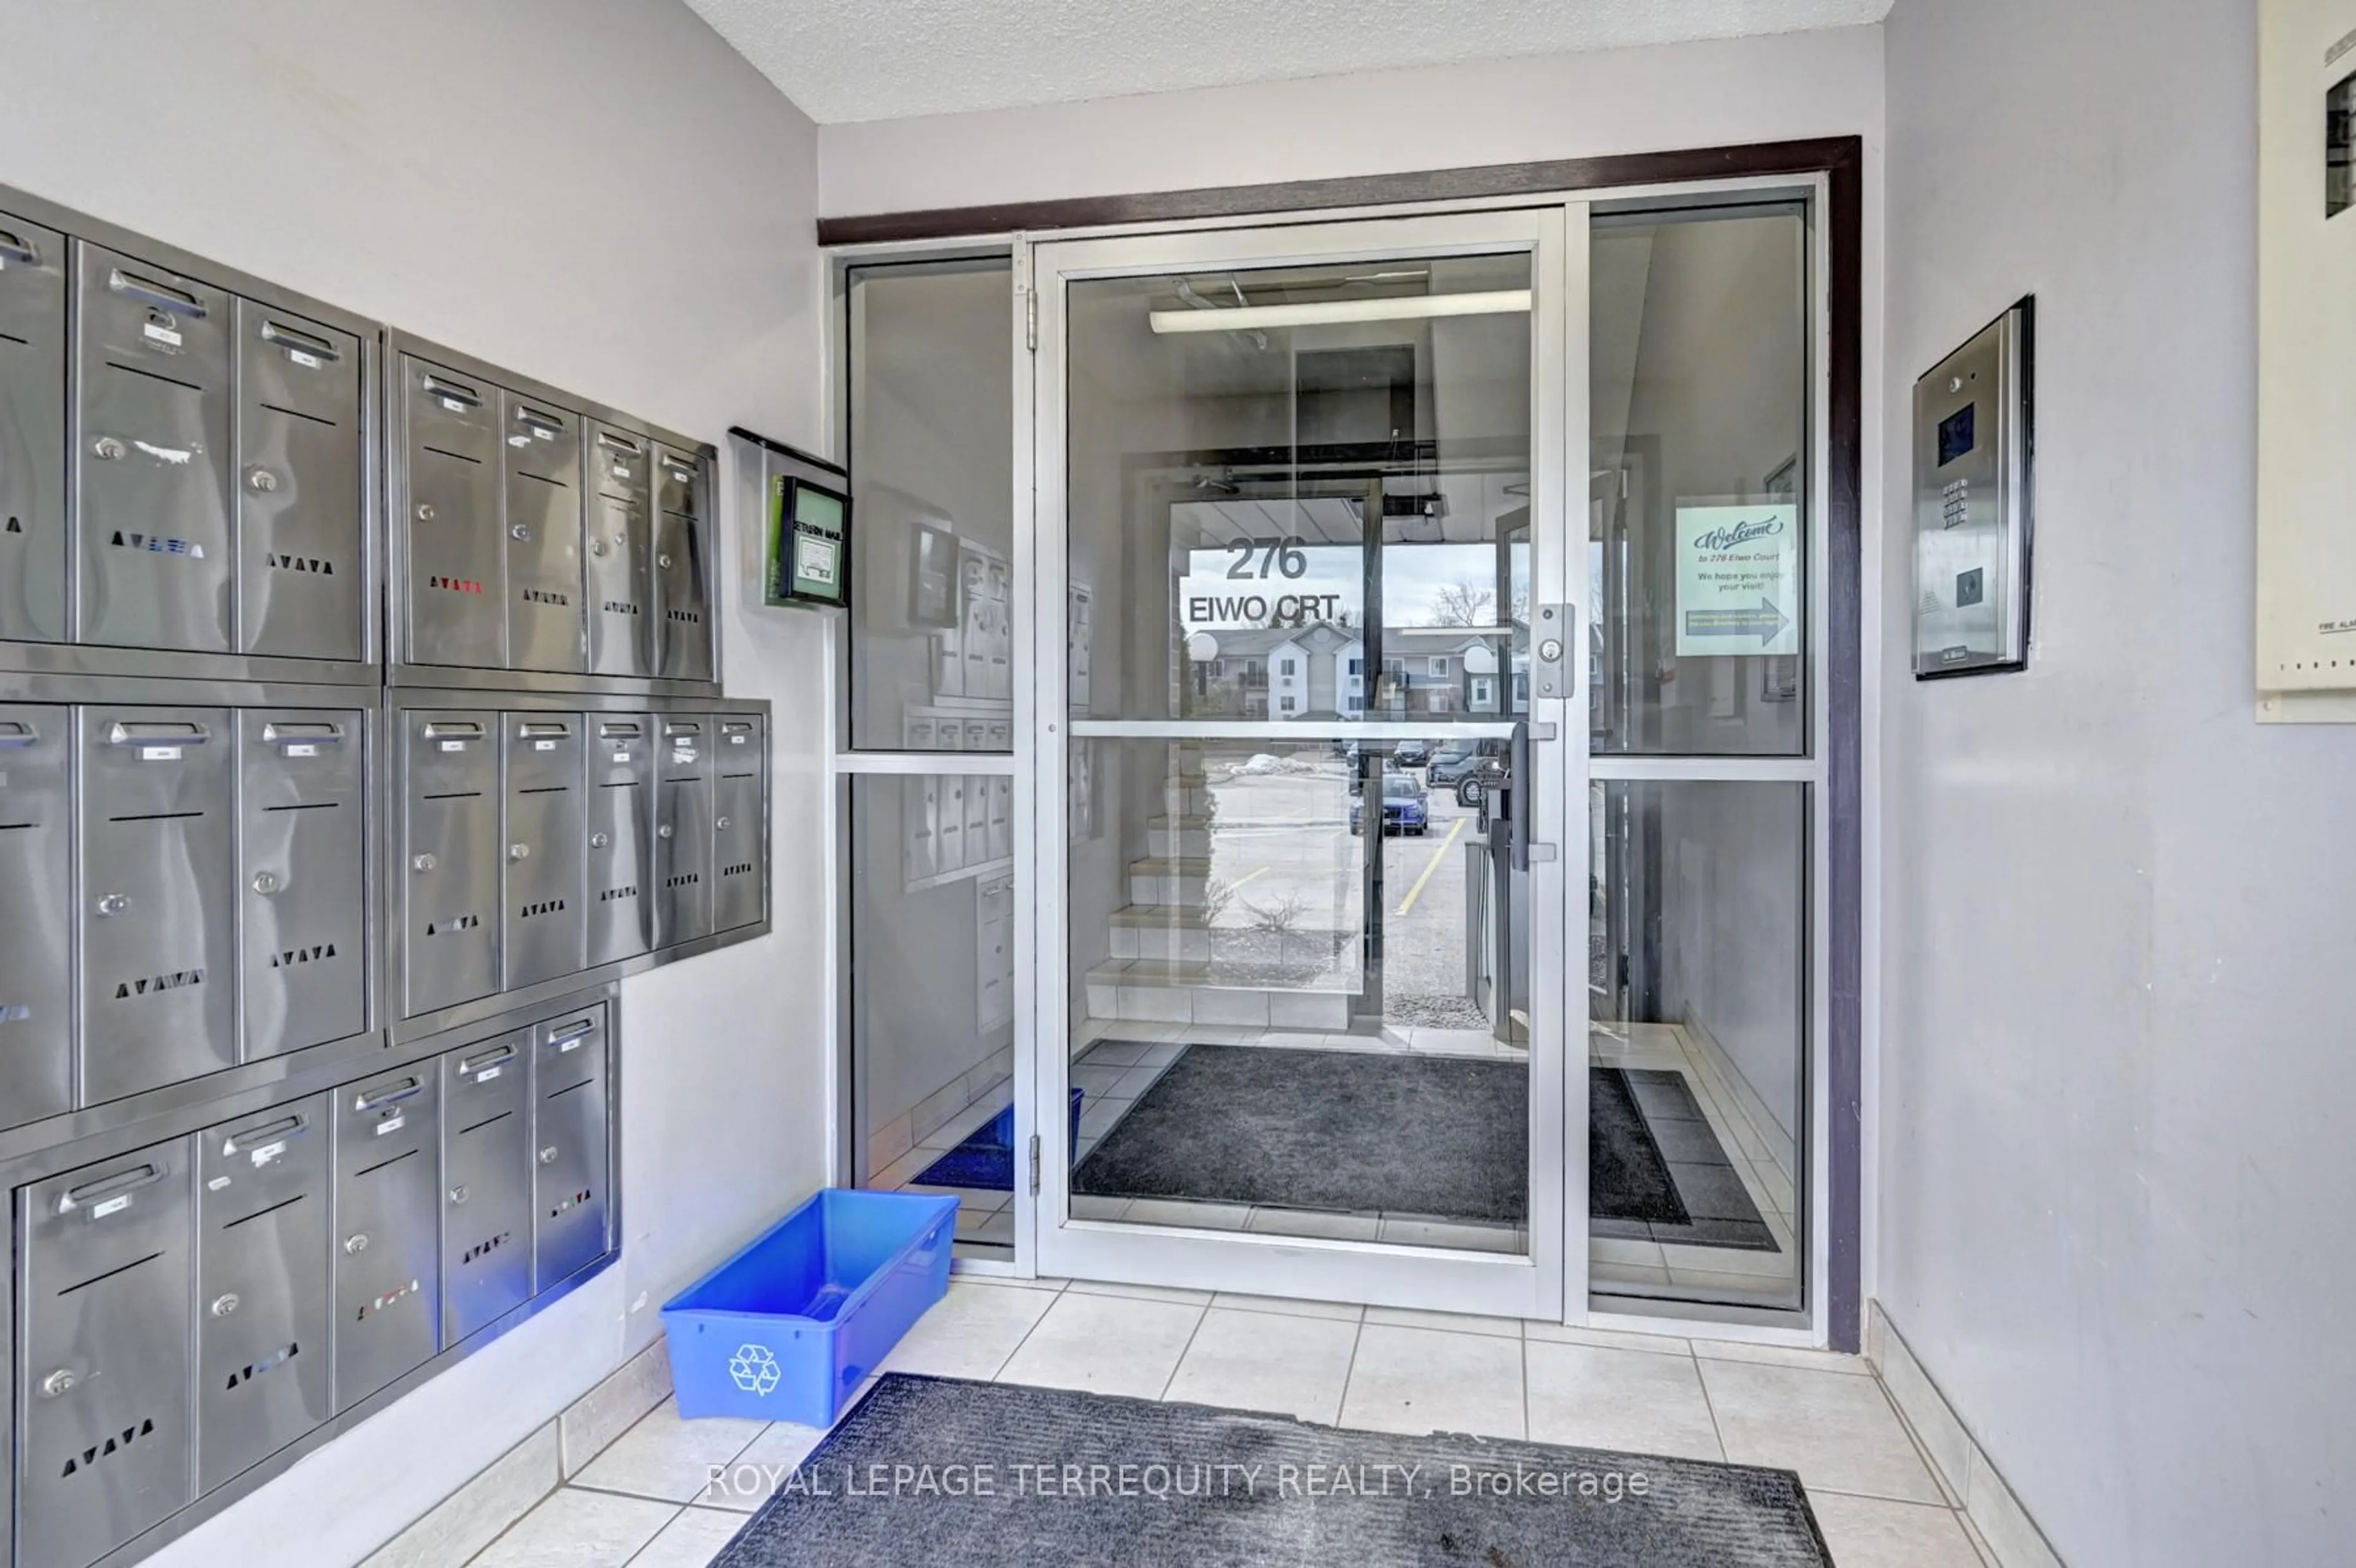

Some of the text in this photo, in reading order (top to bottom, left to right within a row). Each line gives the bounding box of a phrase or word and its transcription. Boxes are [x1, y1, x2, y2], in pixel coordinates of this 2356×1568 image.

[793, 521, 823, 537] ETURN
[1694, 515, 1784, 550] Welcome
[1226, 536, 1307, 579] 276
[1754, 553, 1780, 561] Court
[1715, 573, 1738, 582] hope
[1719, 584, 1739, 593] your
[1190, 594, 1339, 621] EIWO CRT
